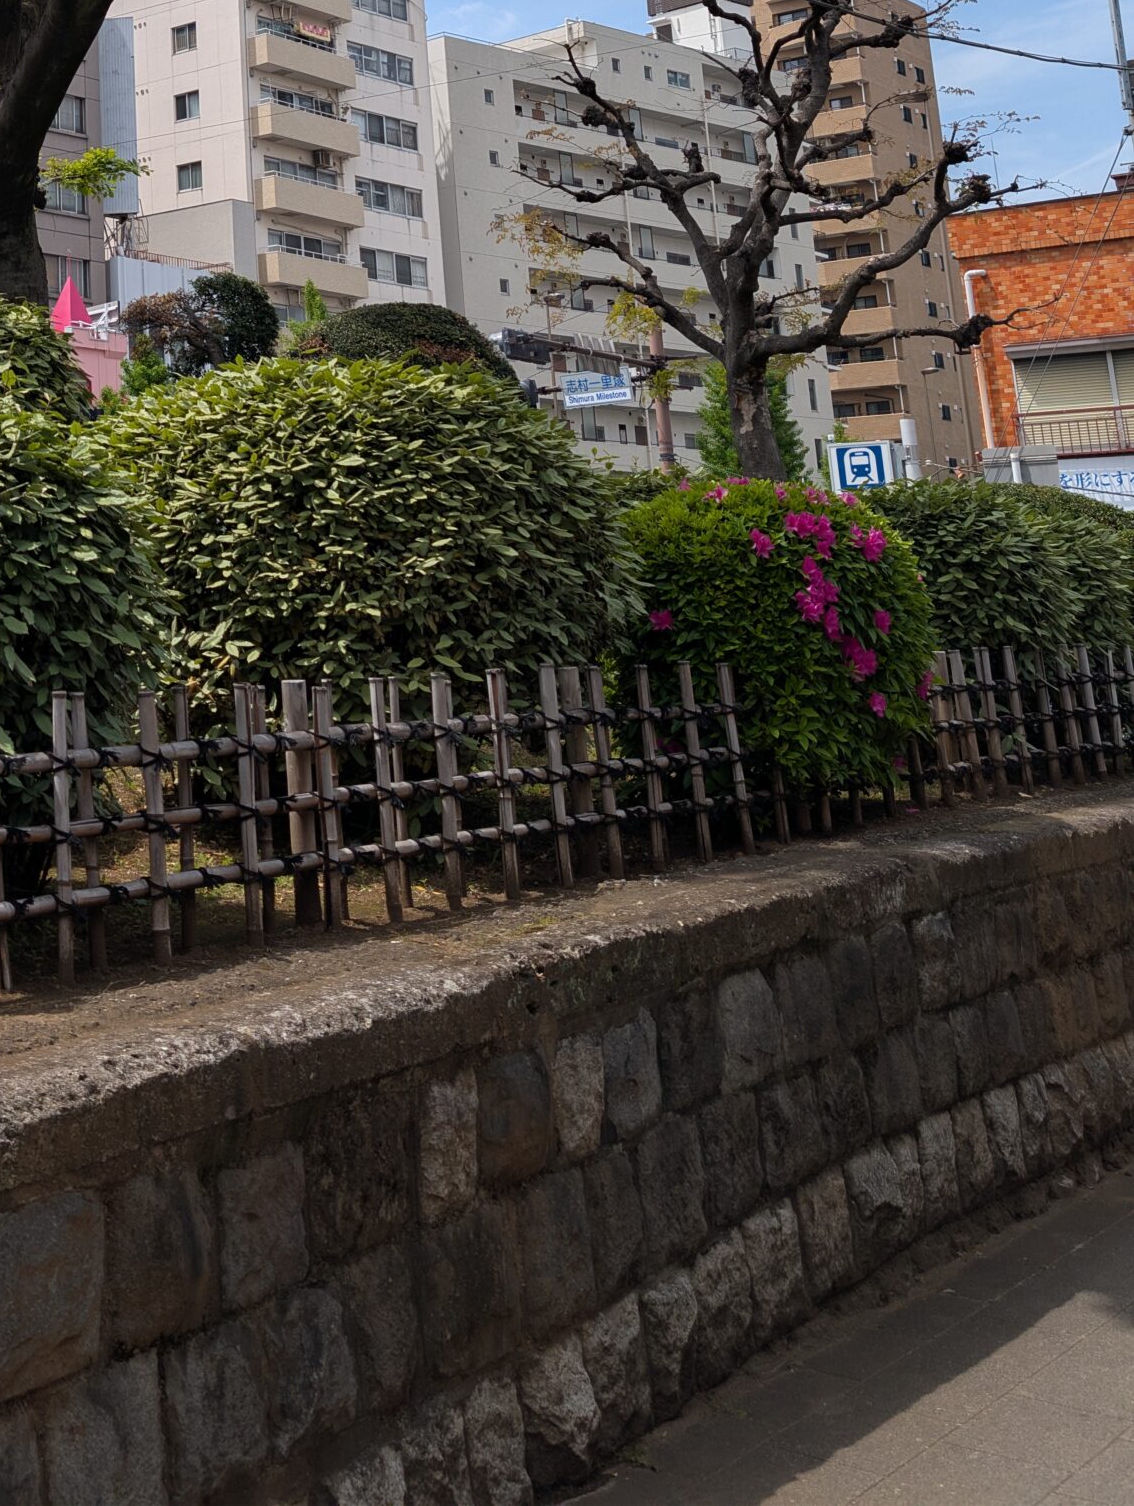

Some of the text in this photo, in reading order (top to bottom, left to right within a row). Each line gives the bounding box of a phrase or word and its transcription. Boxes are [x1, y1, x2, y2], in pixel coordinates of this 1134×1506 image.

[565, 374, 626, 393] 志村一里塚
[568, 391, 628, 404] Shimura Milestone
